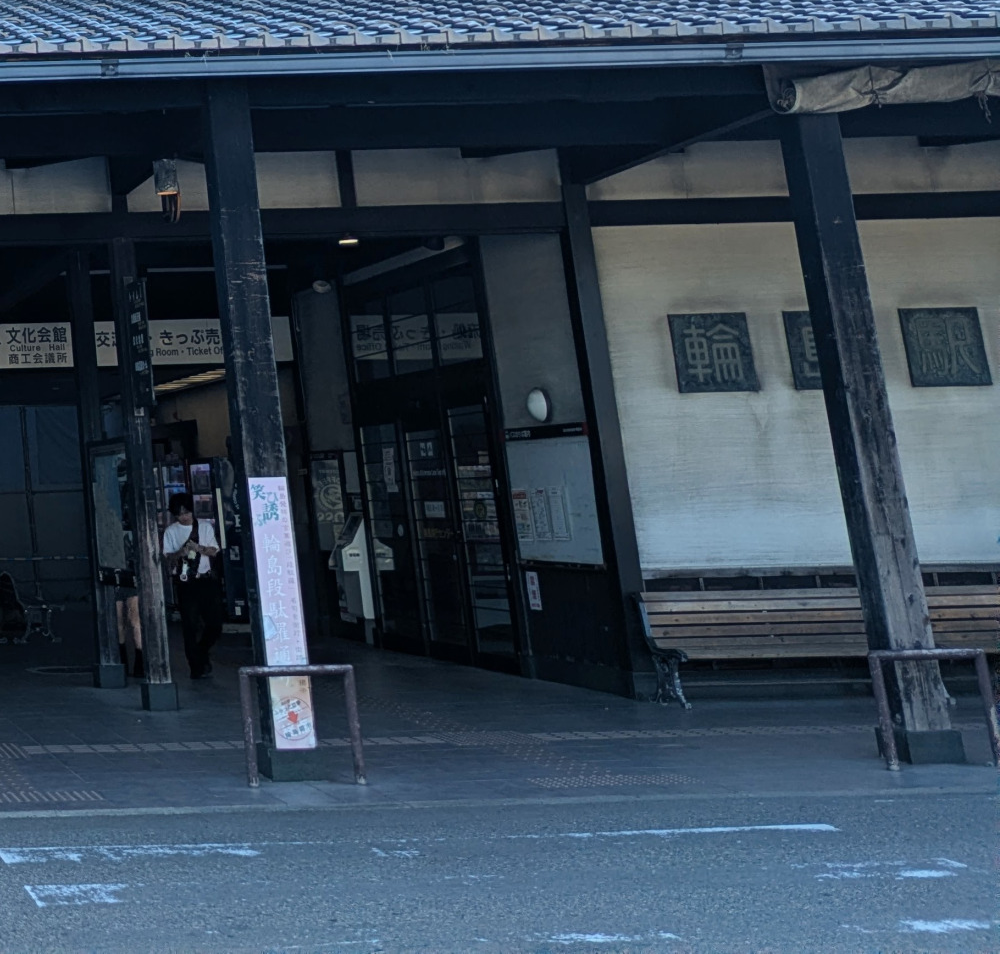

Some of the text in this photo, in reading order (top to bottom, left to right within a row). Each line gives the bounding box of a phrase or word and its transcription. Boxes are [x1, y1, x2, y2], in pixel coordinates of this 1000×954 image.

[5, 327, 67, 344] 文化会館
[9, 343, 65, 352] Culture Hall
[156, 347, 179, 356] Room
[187, 346, 212, 355] Ticket
[8, 352, 68, 365] 商工会議所
